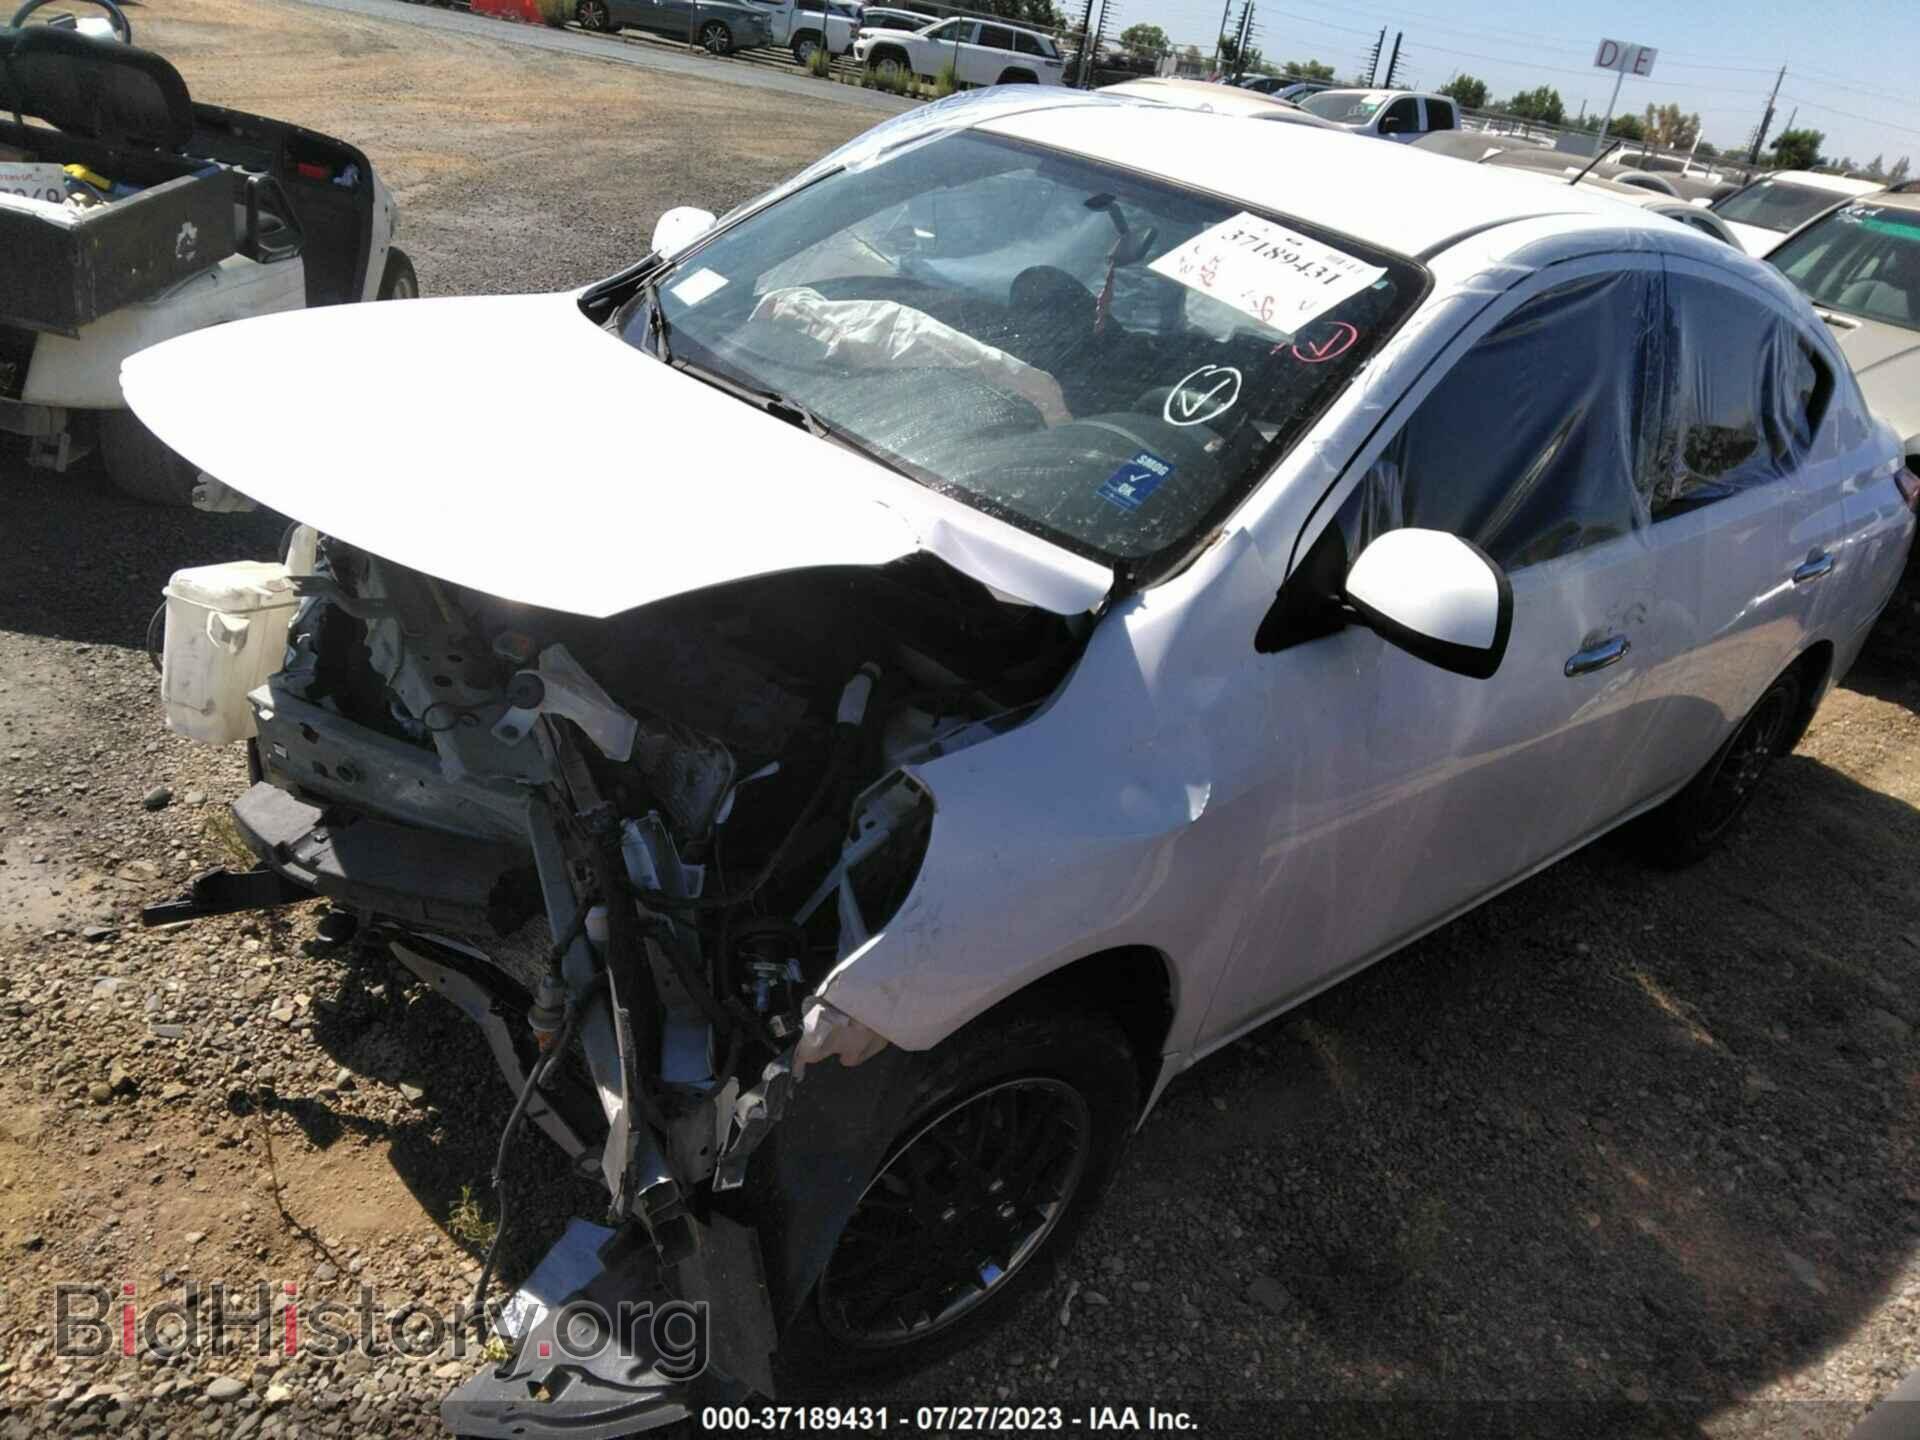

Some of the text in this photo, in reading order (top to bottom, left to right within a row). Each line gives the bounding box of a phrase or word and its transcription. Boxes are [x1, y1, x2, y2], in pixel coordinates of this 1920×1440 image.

[1599, 39, 1649, 75] D E
[1221, 228, 1342, 287] 37189431
[1136, 454, 1169, 477] SMOG
